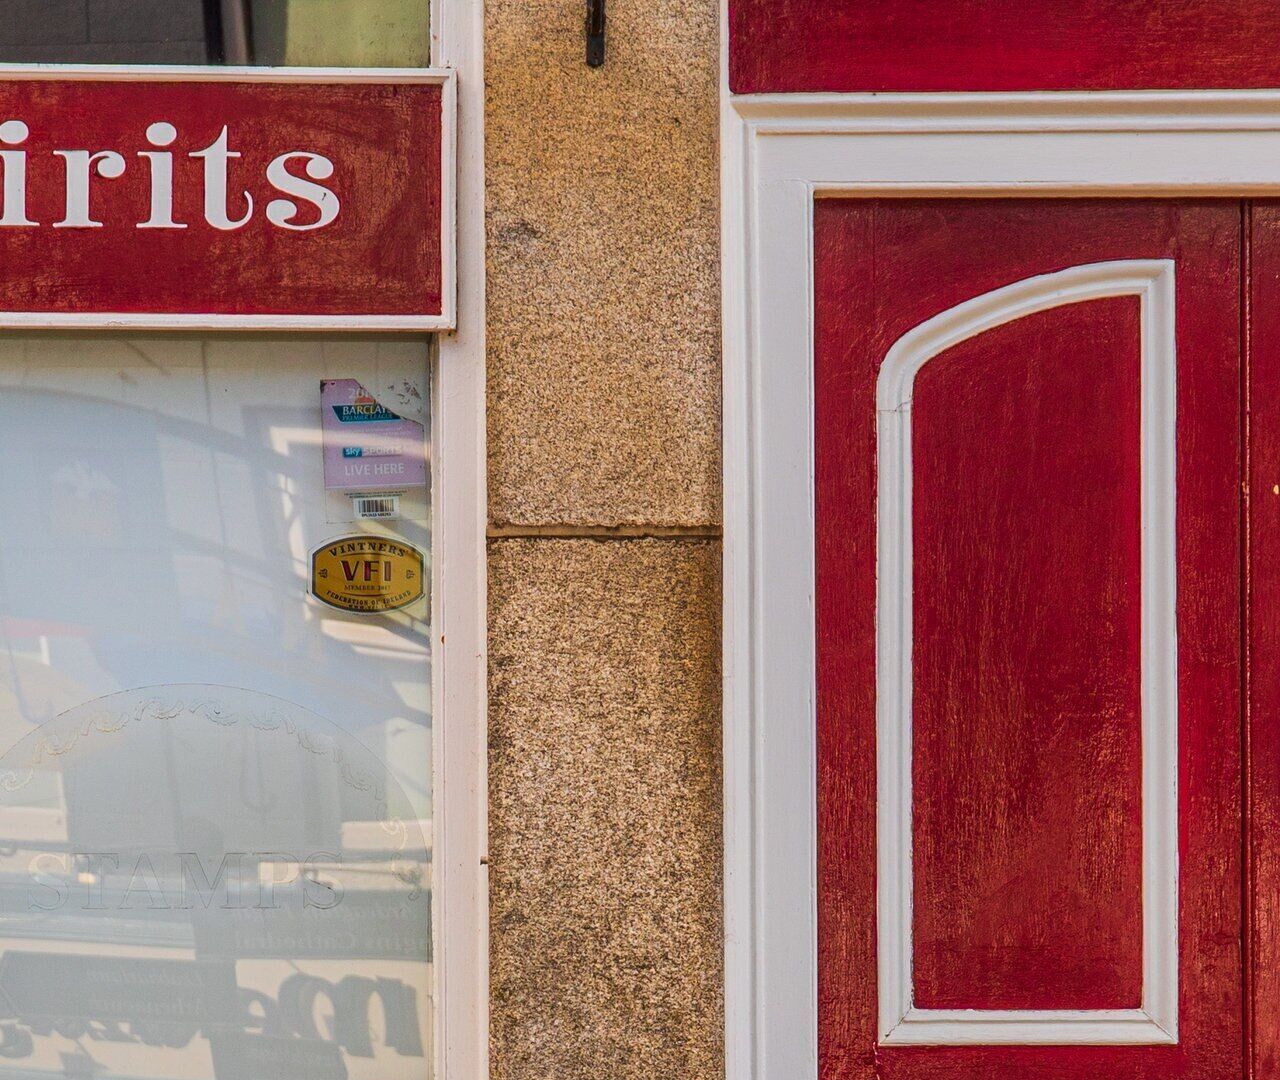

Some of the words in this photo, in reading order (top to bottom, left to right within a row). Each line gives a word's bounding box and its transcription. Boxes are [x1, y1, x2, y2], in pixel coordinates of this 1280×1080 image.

[342, 405, 391, 415] BARCLAY
[344, 464, 371, 476] LIVE
[374, 463, 405, 475] HERE
[340, 561, 391, 581] VFI
[27, 851, 344, 911] STAMPS
